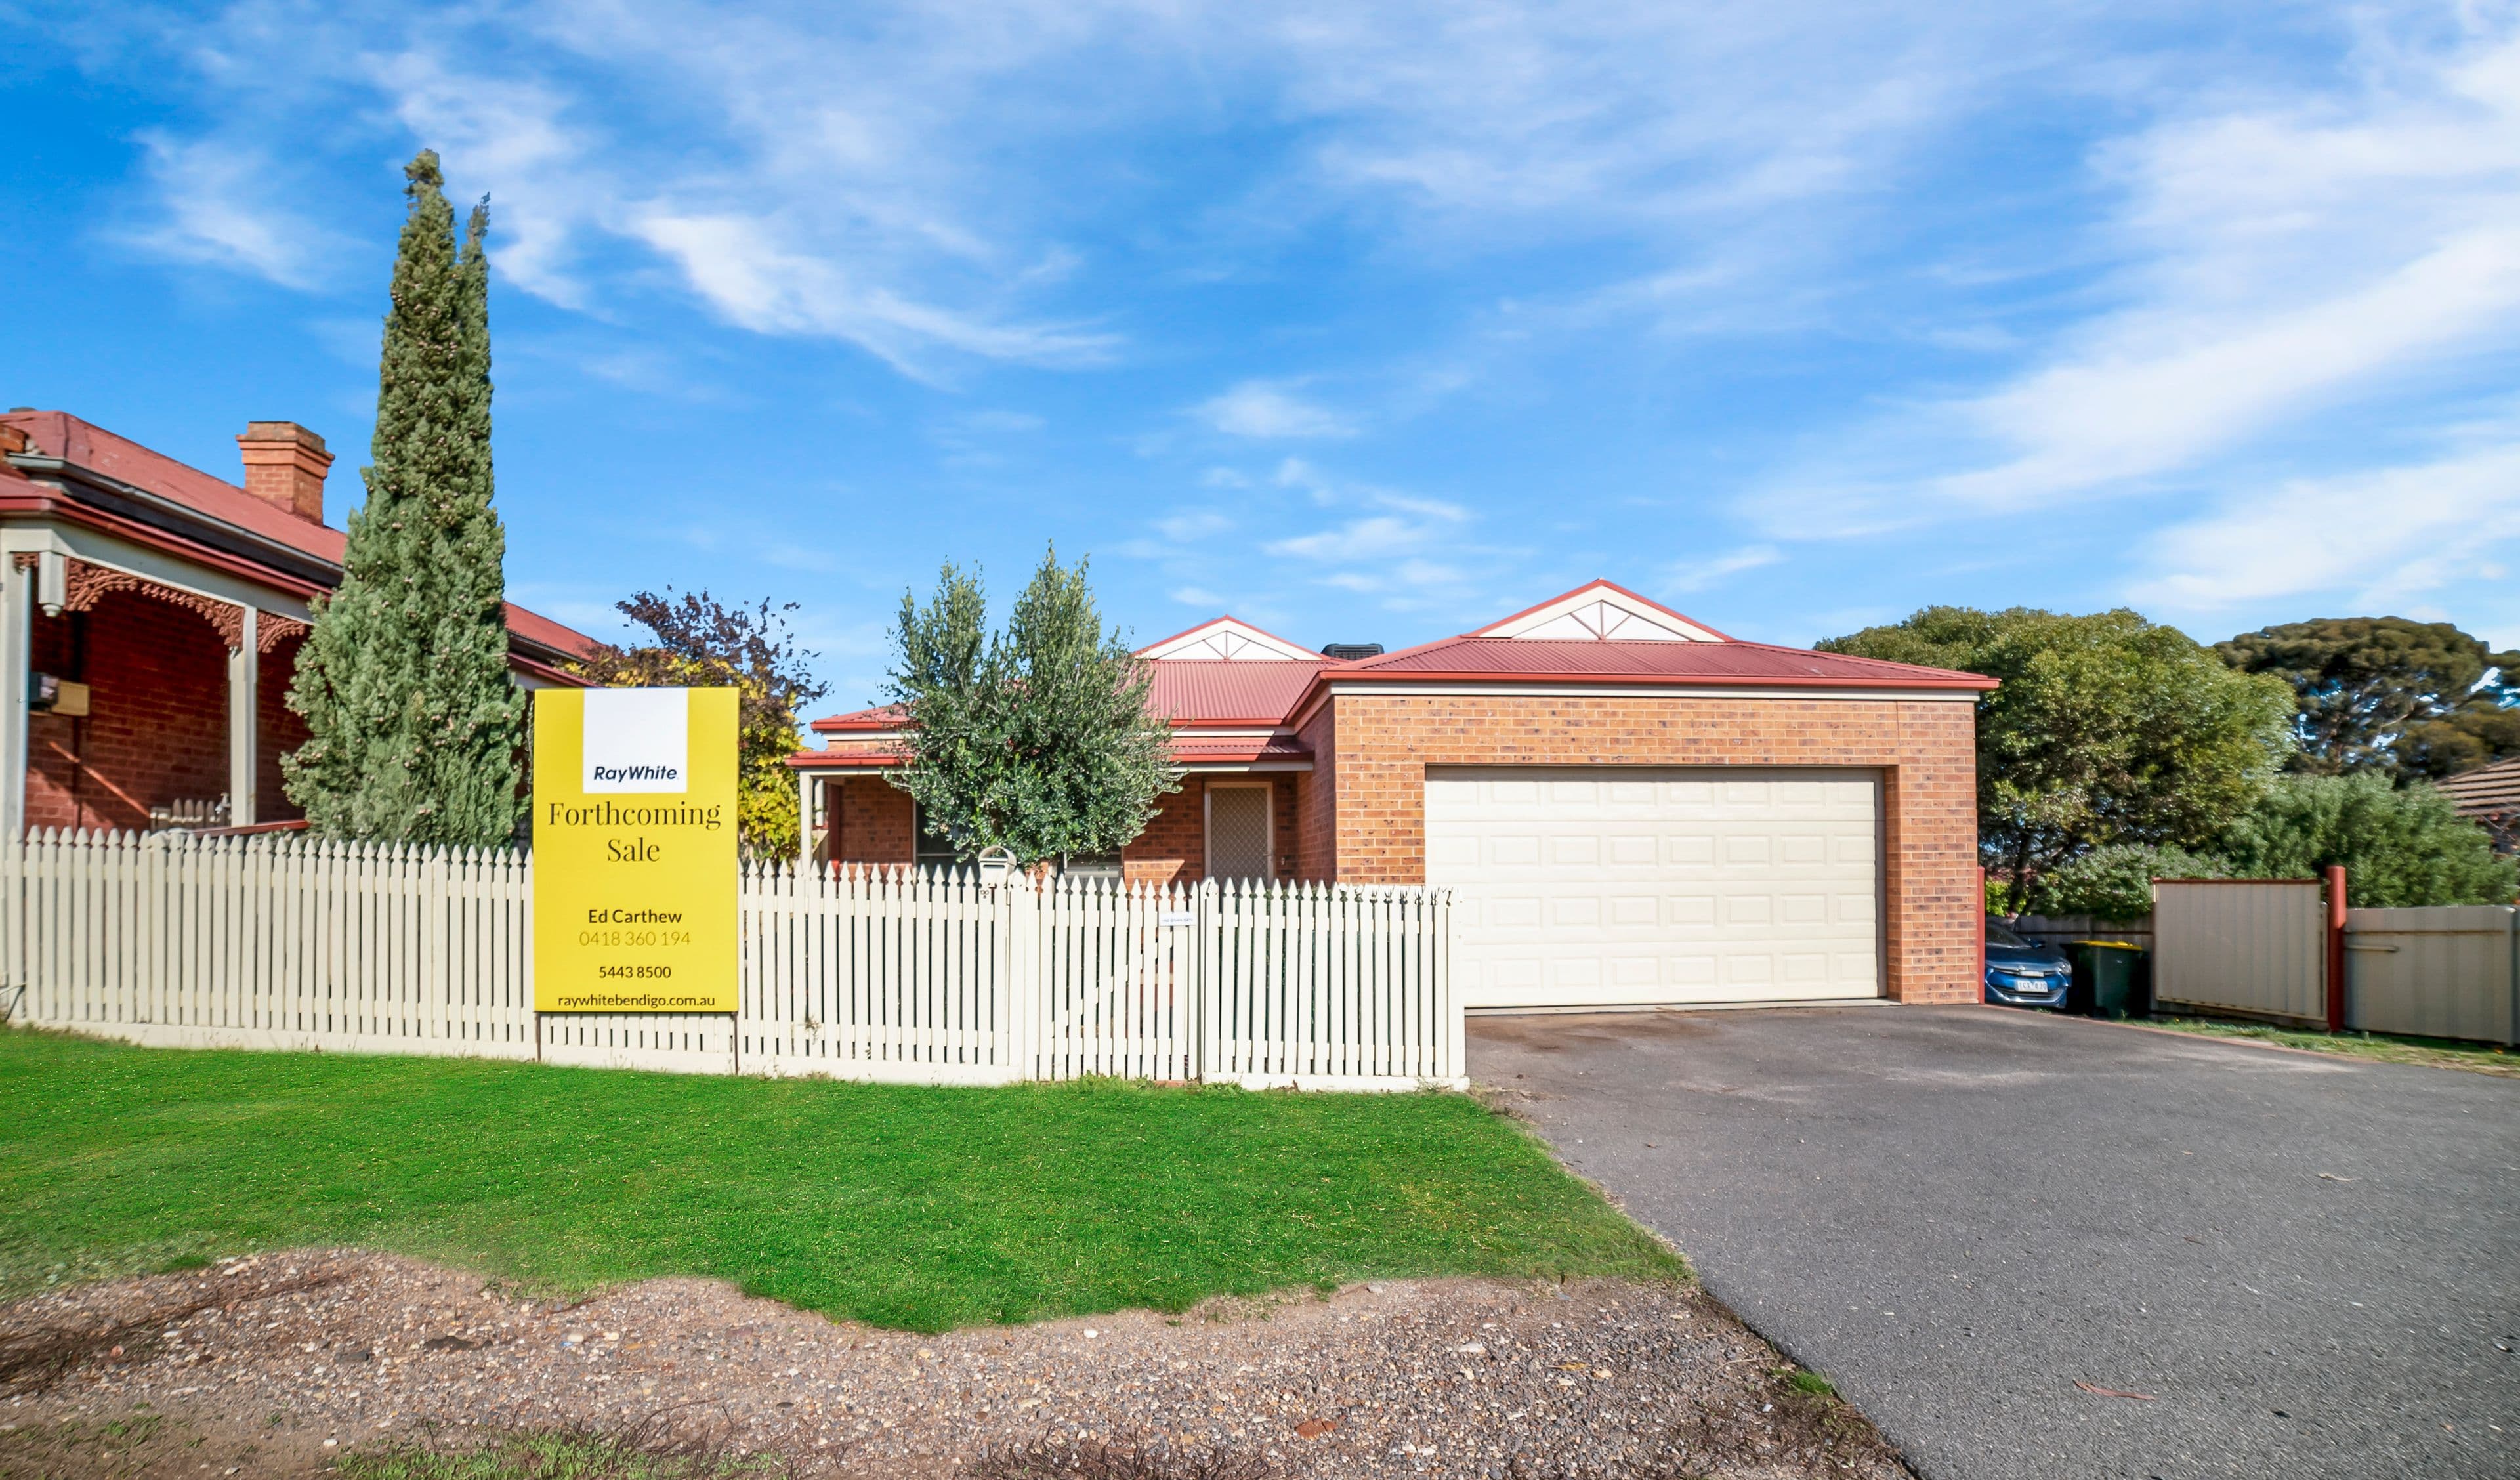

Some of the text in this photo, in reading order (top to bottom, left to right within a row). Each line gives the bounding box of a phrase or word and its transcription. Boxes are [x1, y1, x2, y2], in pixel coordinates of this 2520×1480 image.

[549, 801, 721, 830] Forthcoming
[607, 837, 660, 862] Sale
[589, 908, 682, 923] Ed Carthew
[579, 931, 690, 946] 0418 360 194
[599, 966, 671, 978] 5443 8500
[558, 994, 715, 1009] raywhitebendigo.com.au
